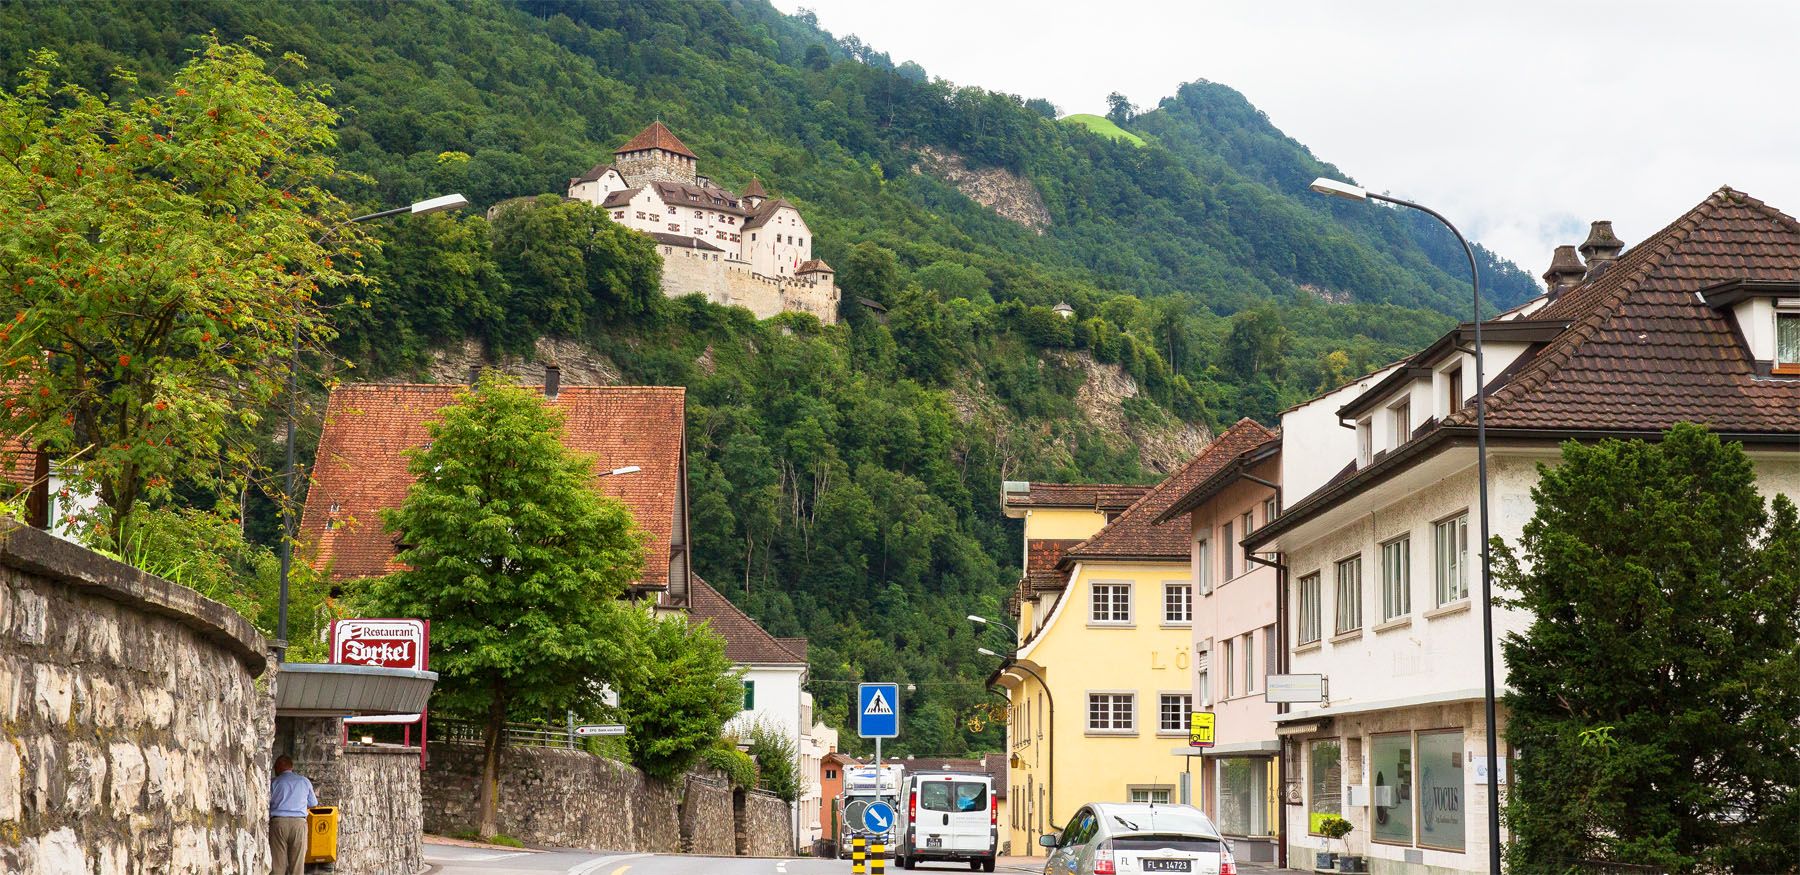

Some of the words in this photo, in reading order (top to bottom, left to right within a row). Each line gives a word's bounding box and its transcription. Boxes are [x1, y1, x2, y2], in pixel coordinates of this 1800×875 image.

[363, 627, 414, 637] Restaurant
[345, 640, 412, 662] Torkel
[1121, 856, 1129, 866] FL
[1147, 861, 1157, 869] FL
[1165, 861, 1188, 870] 14723
